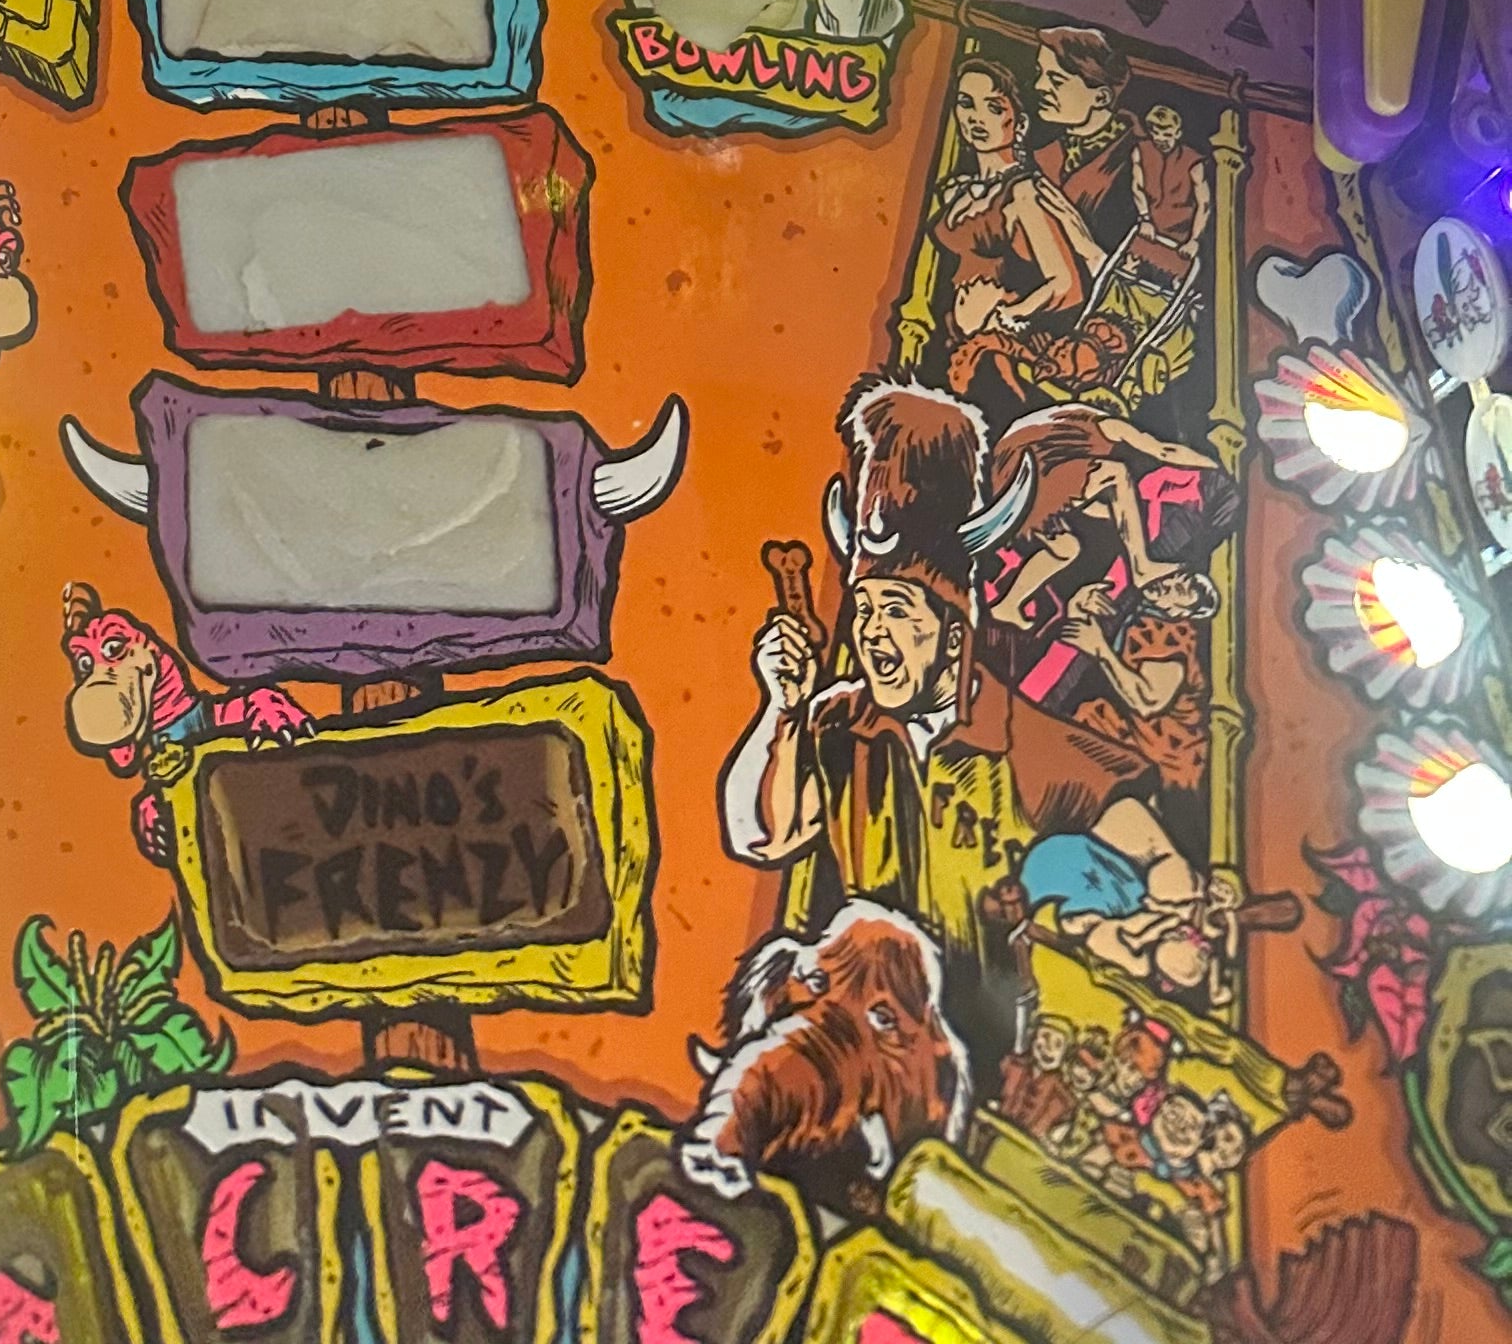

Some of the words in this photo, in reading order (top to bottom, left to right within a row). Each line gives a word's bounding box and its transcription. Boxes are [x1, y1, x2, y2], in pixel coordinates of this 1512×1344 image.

[631, 17, 877, 108] BOWLING
[300, 755, 506, 838] DINO'S
[259, 822, 573, 948] FRENZY
[223, 1092, 517, 1131] INVENT
